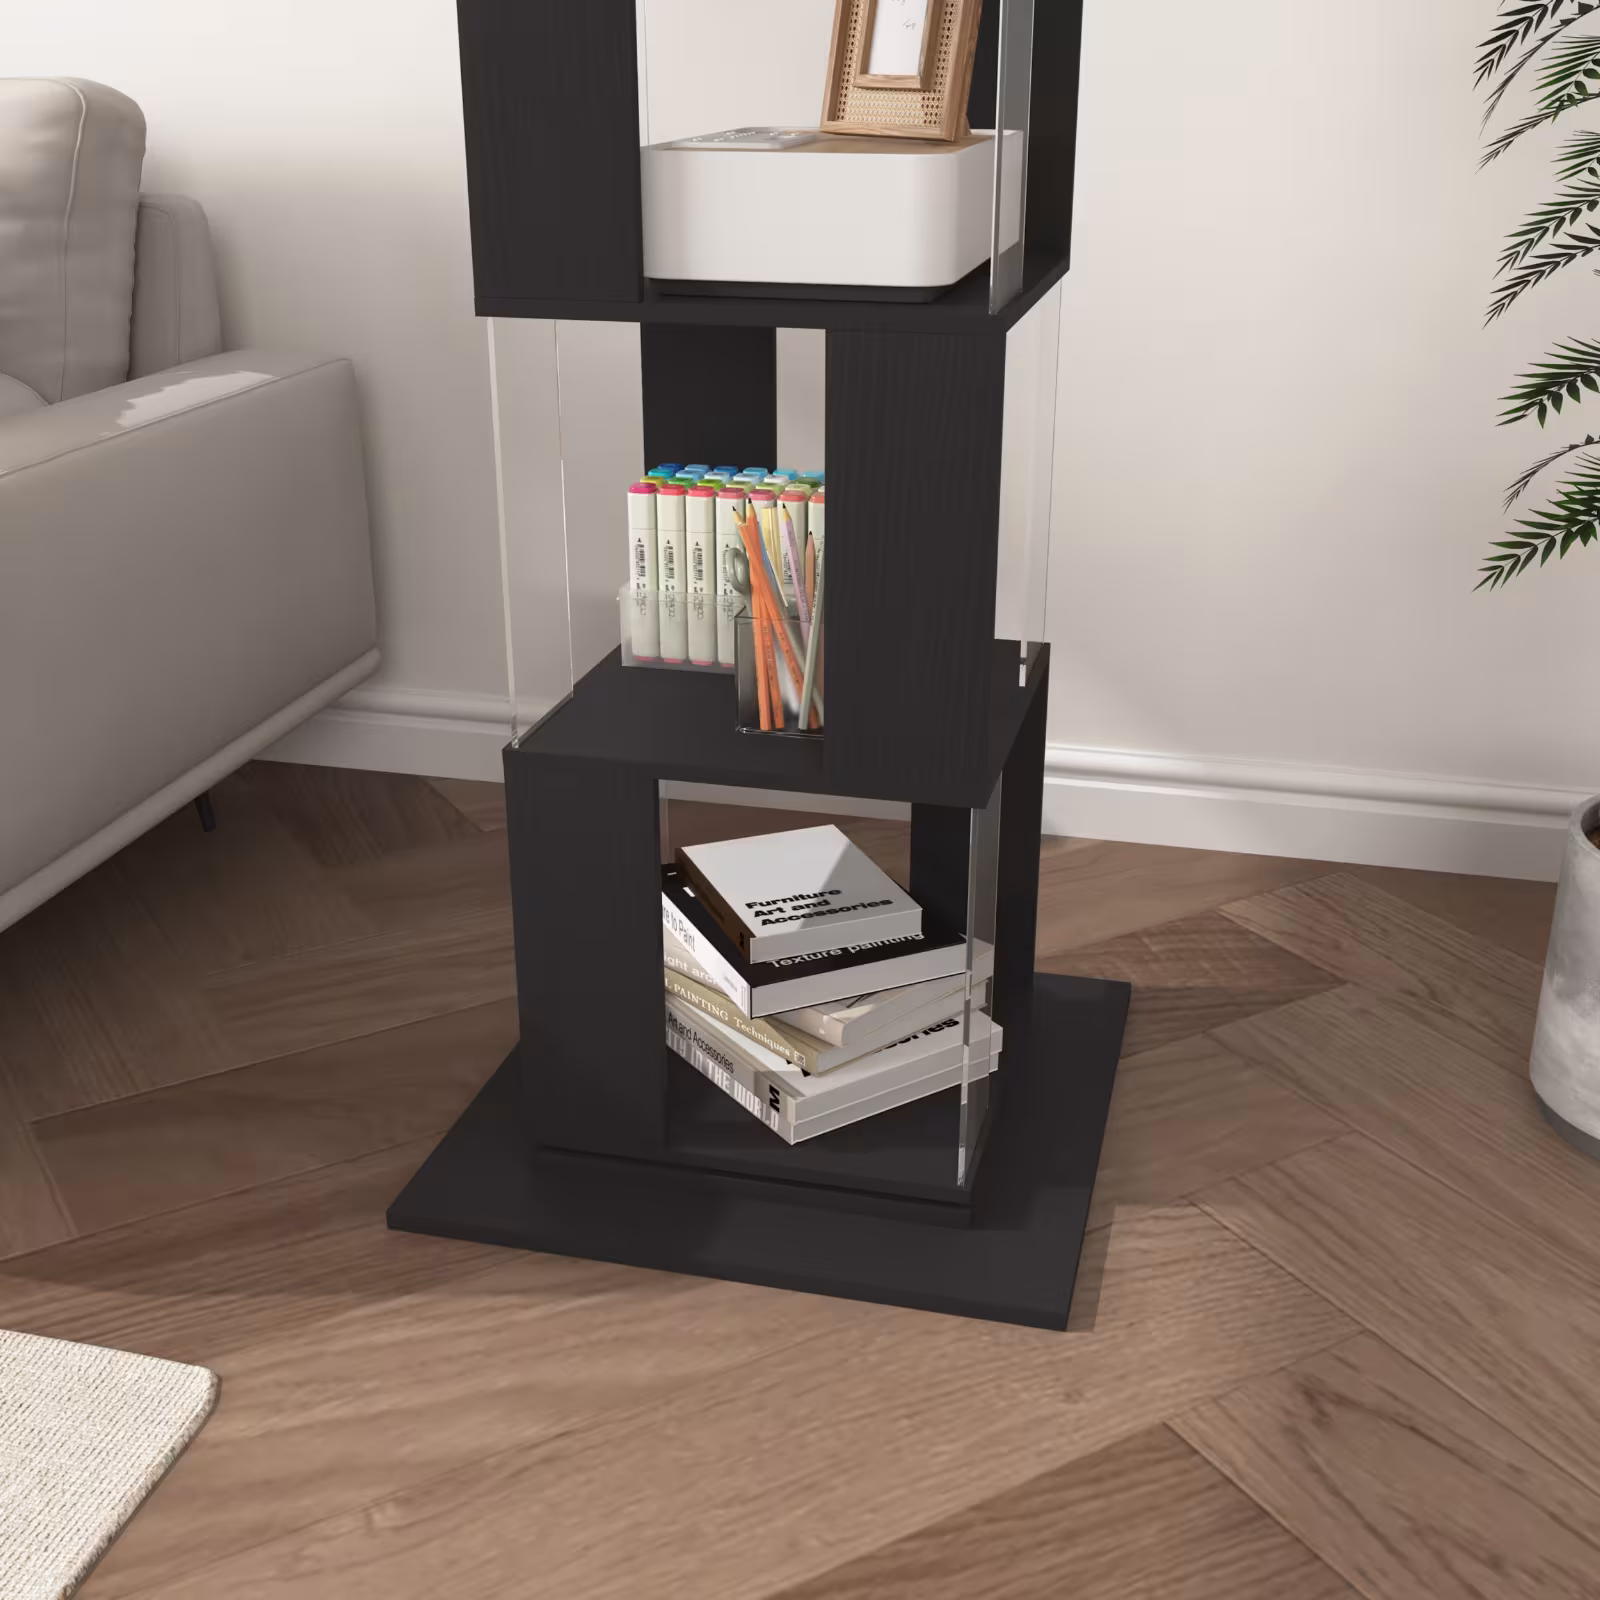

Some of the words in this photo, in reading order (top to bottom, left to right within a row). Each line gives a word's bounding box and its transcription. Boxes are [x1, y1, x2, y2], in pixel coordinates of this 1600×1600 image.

[745, 887, 842, 909] Furniture
[753, 906, 785, 918] Art
[791, 898, 831, 911] and
[761, 898, 894, 926] Accessories
[671, 911, 678, 932] to
[679, 919, 696, 953] Paint
[767, 948, 841, 968] Texture
[848, 932, 925, 954] painting
[674, 983, 729, 1022] PAINTING
[734, 1016, 791, 1057] Techniques
[668, 1012, 678, 1035] Art
[678, 1022, 692, 1041] and
[692, 1031, 734, 1074] Accessories
[706, 1059, 731, 1092] THE
[734, 1079, 780, 1132] WORLD
[768, 1084, 780, 1113] M
